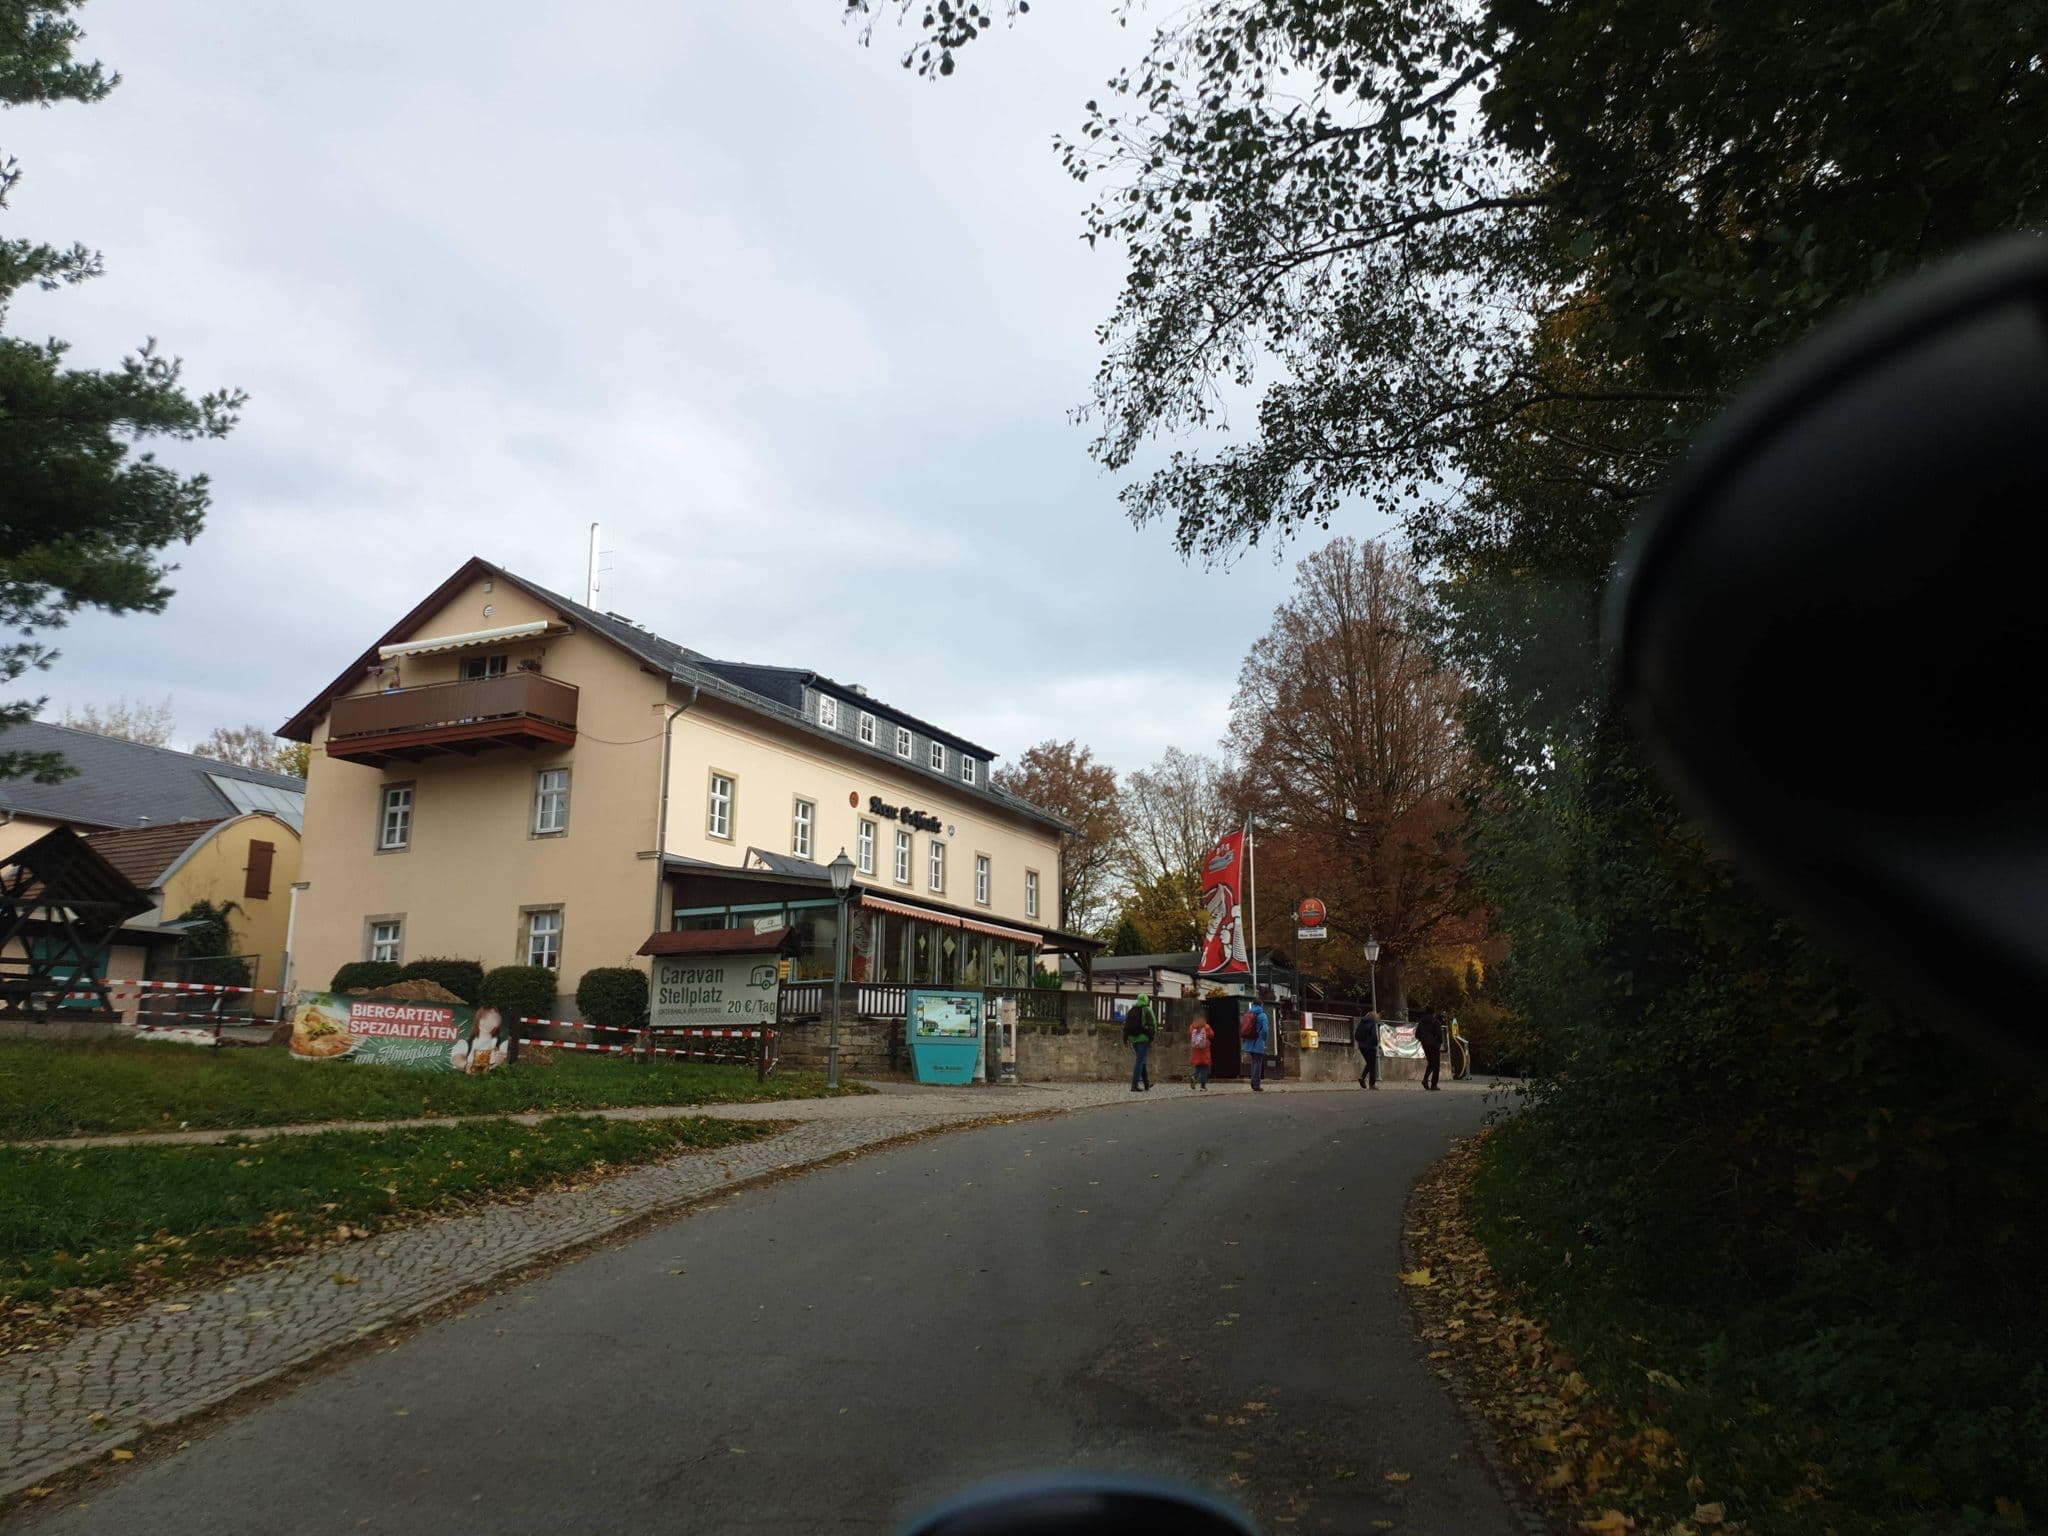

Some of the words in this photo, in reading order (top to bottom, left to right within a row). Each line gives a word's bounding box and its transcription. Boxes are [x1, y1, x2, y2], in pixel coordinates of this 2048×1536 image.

[661, 966, 724, 985] Caravan
[659, 987, 723, 1008] Stellplatz
[727, 1000, 741, 1014] 20
[745, 999, 776, 1015] €/Tag
[352, 1003, 451, 1023] BIERGARTEN-
[350, 1020, 459, 1040] SPEZIALITÄTEN
[376, 1044, 443, 1066] Königstein
